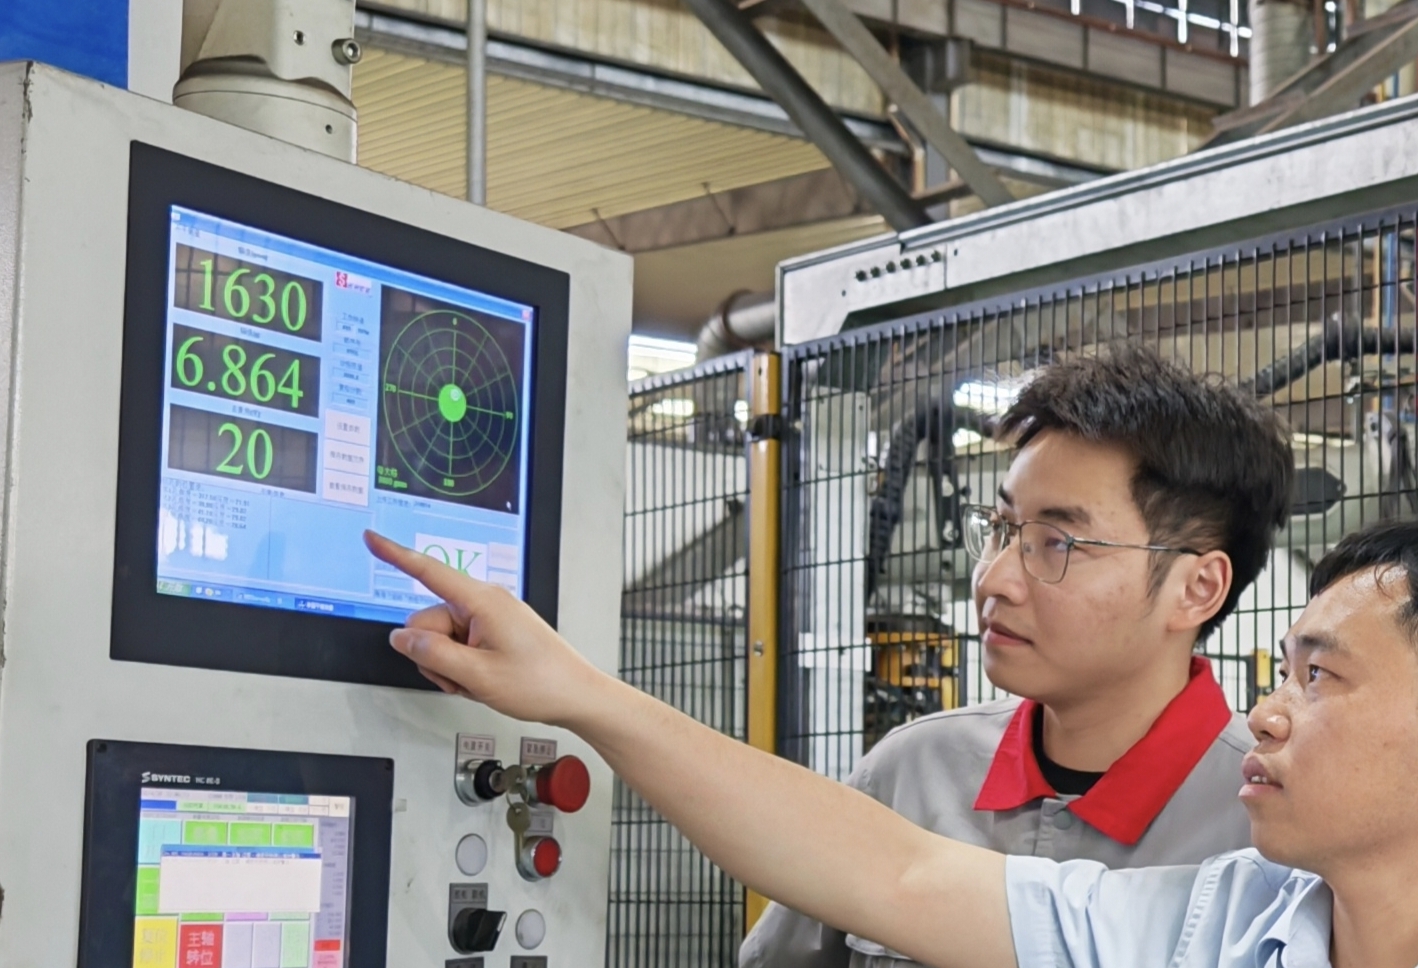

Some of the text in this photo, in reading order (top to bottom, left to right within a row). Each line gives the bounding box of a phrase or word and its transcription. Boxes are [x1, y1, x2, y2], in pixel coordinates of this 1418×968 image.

[199, 259, 307, 331] 1630
[176, 336, 304, 409] 6.864
[216, 422, 273, 479] 20
